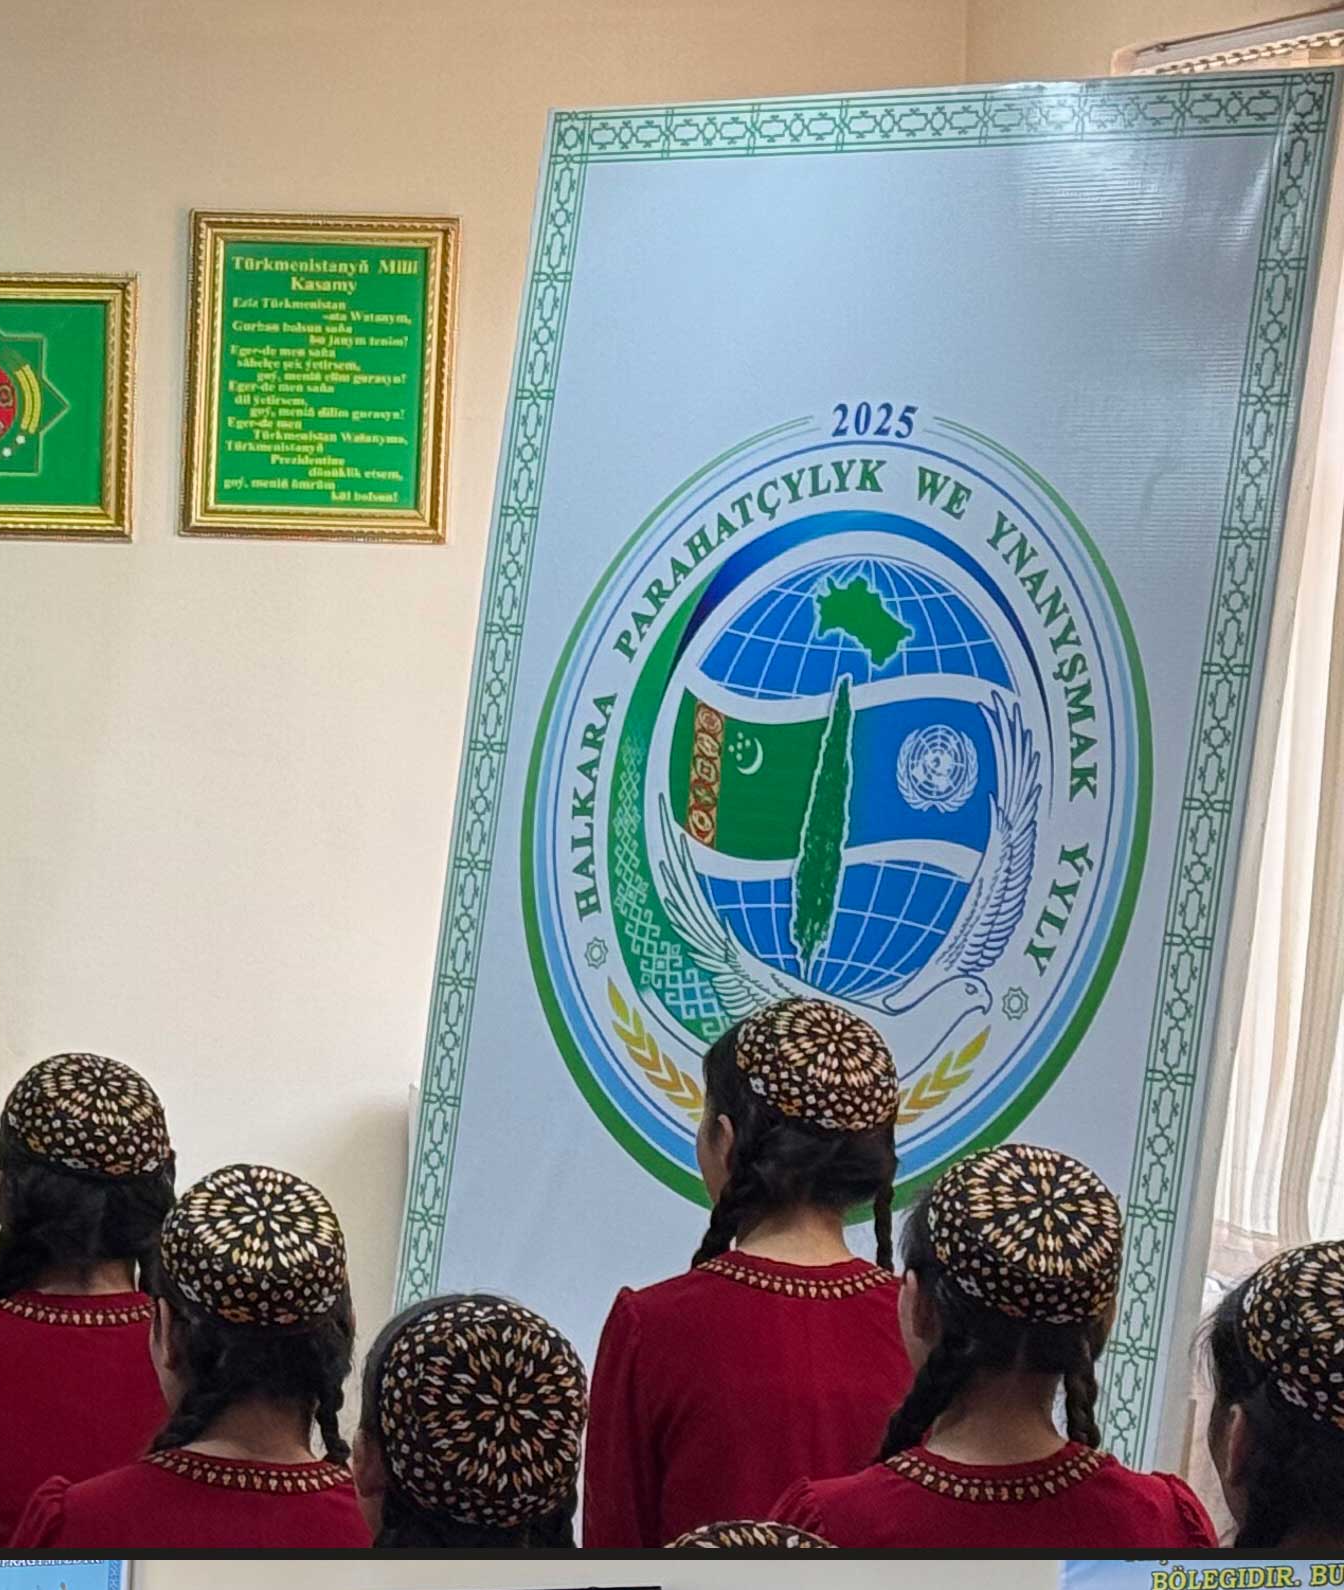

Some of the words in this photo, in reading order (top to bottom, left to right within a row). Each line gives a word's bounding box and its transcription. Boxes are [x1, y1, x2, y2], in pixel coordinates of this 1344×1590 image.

[232, 256, 369, 276] Türkmenistanyň
[291, 276, 357, 295] Kasamy
[831, 402, 918, 439] 2025
[916, 466, 973, 520] WE
[612, 458, 887, 663] PARAHATÇYLYK
[986, 511, 1098, 802] YNANYŞMAK
[570, 692, 617, 923] HALKARA
[1024, 842, 1094, 977] ÝYLY
[1309, 1563, 1344, 1587] BU
